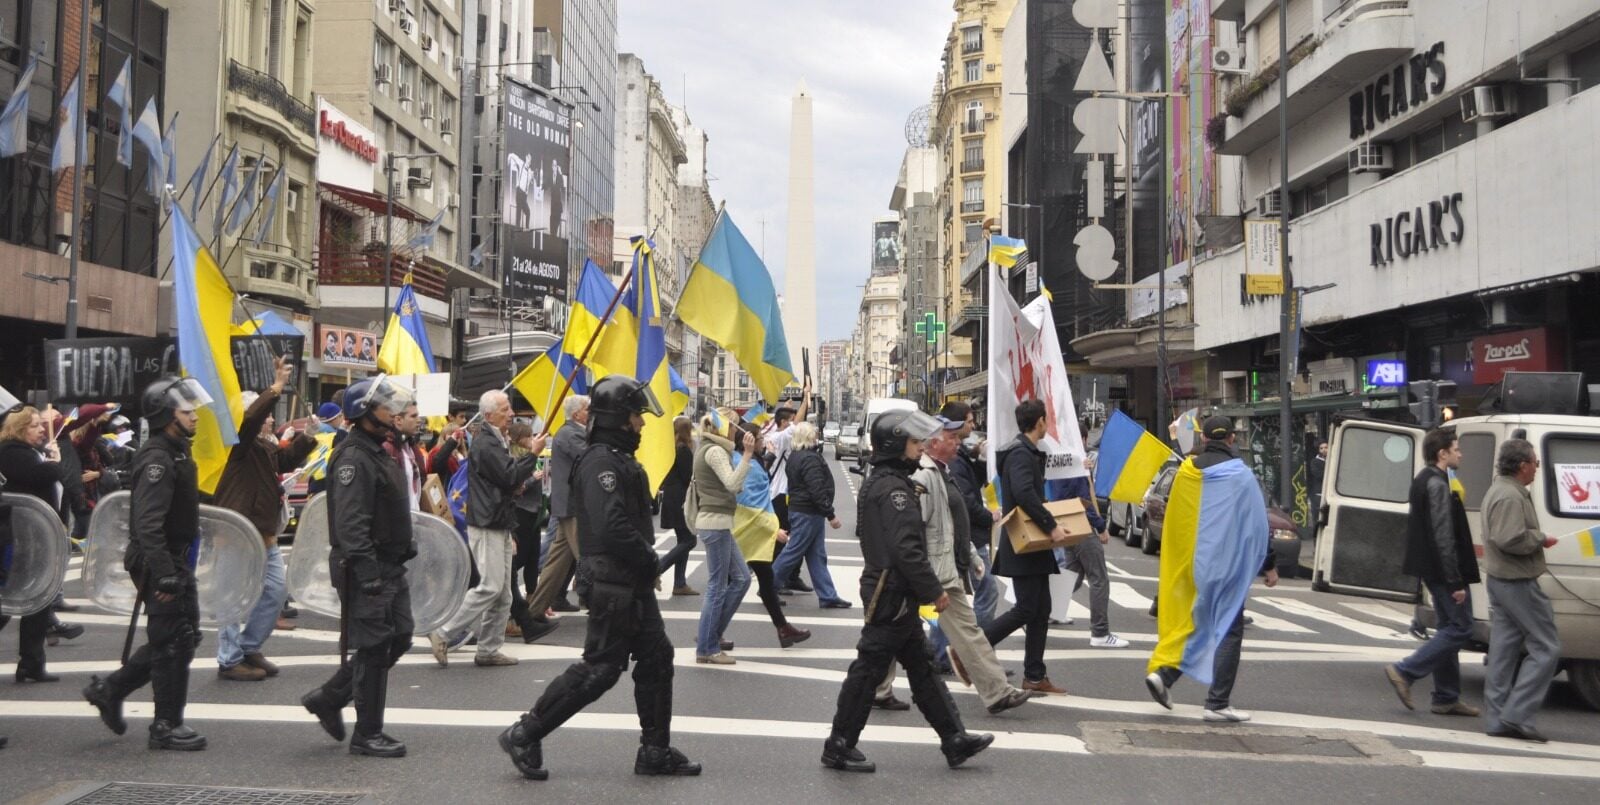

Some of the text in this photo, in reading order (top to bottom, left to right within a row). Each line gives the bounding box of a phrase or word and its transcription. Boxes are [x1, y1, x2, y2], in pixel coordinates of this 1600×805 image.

[1349, 41, 1446, 140] RIGAR'S
[508, 111, 570, 148] THE OLD WOMAN
[1369, 192, 1464, 267] RIGAR'S
[512, 256, 519, 272] 21
[525, 258, 532, 274] 24
[538, 261, 560, 281] AGOSTO
[57, 345, 135, 398] FUERA
[134, 356, 160, 374] LAS
[1371, 362, 1405, 384] ASH
